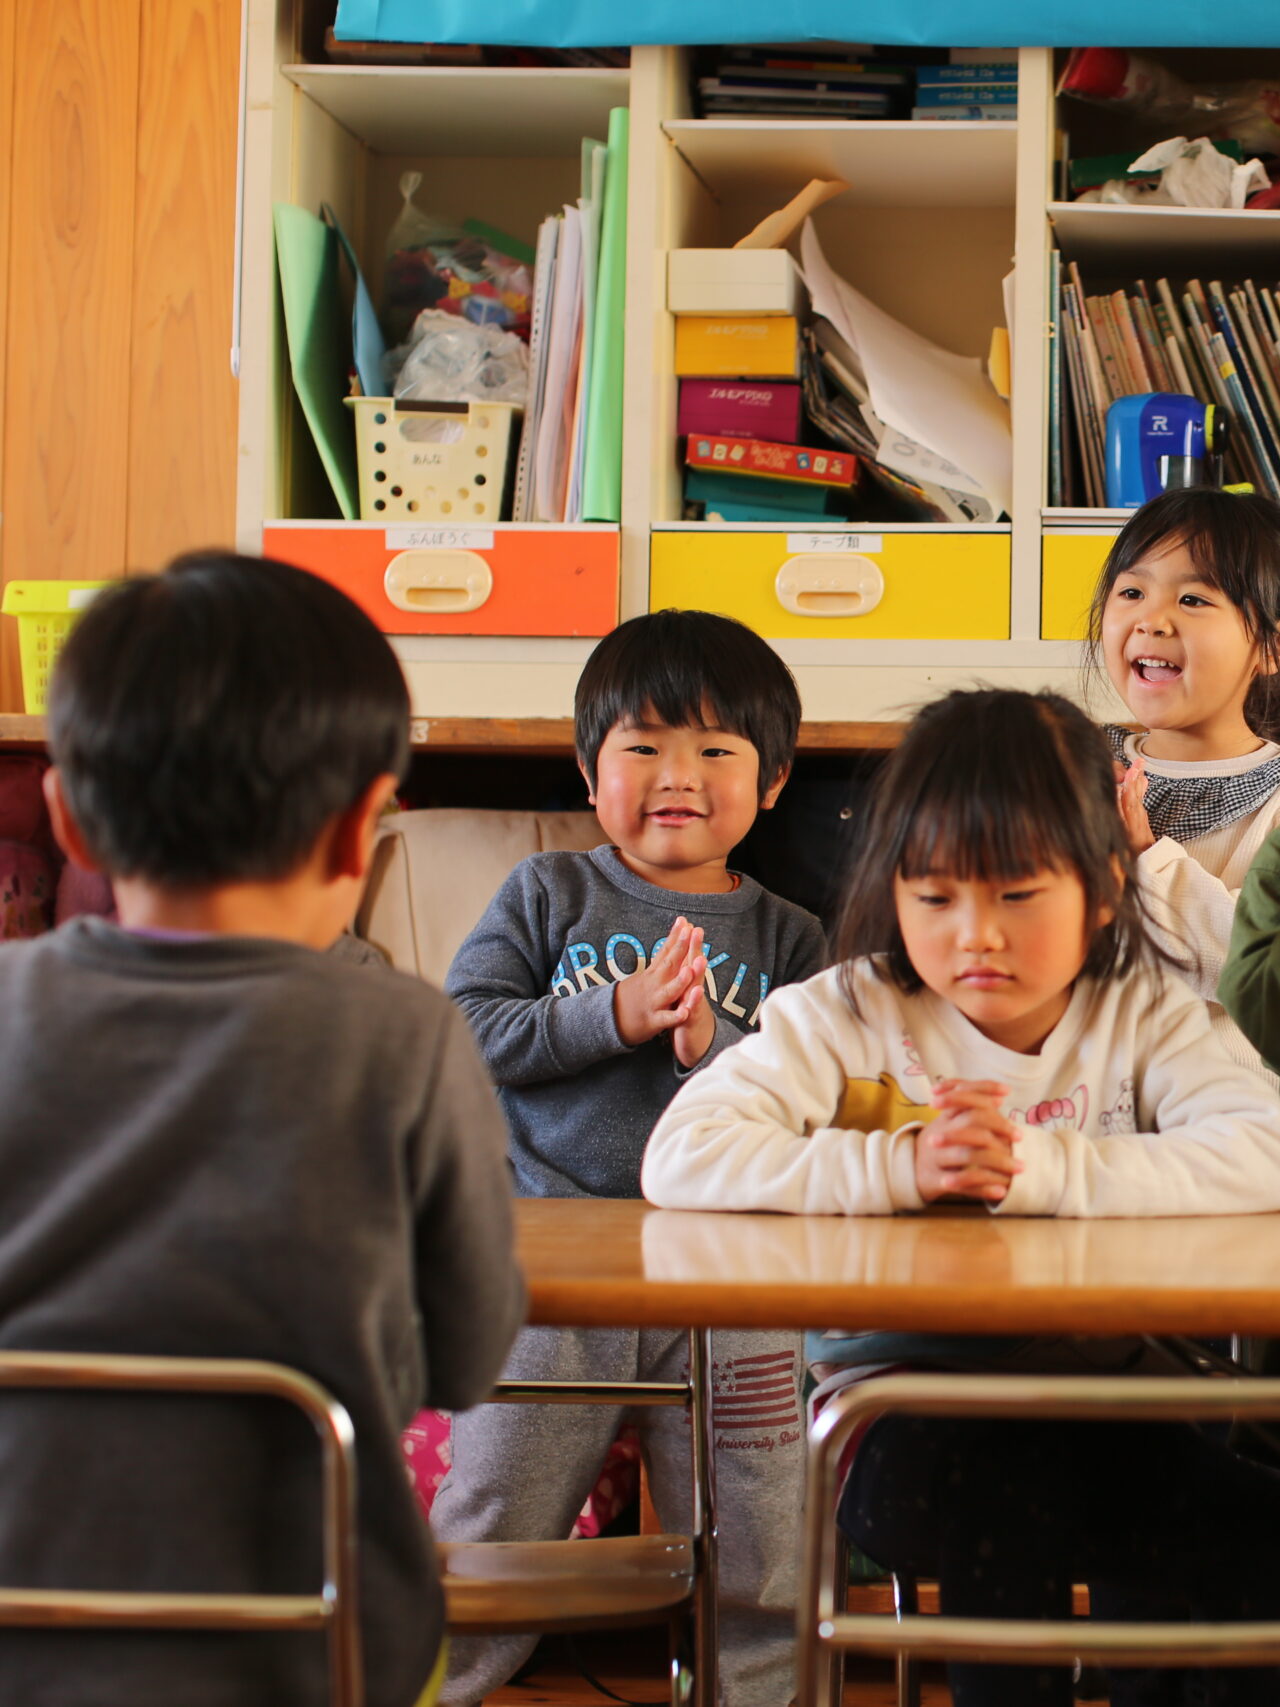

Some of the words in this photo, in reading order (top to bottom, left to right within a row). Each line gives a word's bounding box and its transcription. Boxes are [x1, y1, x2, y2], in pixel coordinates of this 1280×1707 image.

[408, 532, 470, 545] ぶんぼうぐ
[810, 535, 860, 549] テープ類
